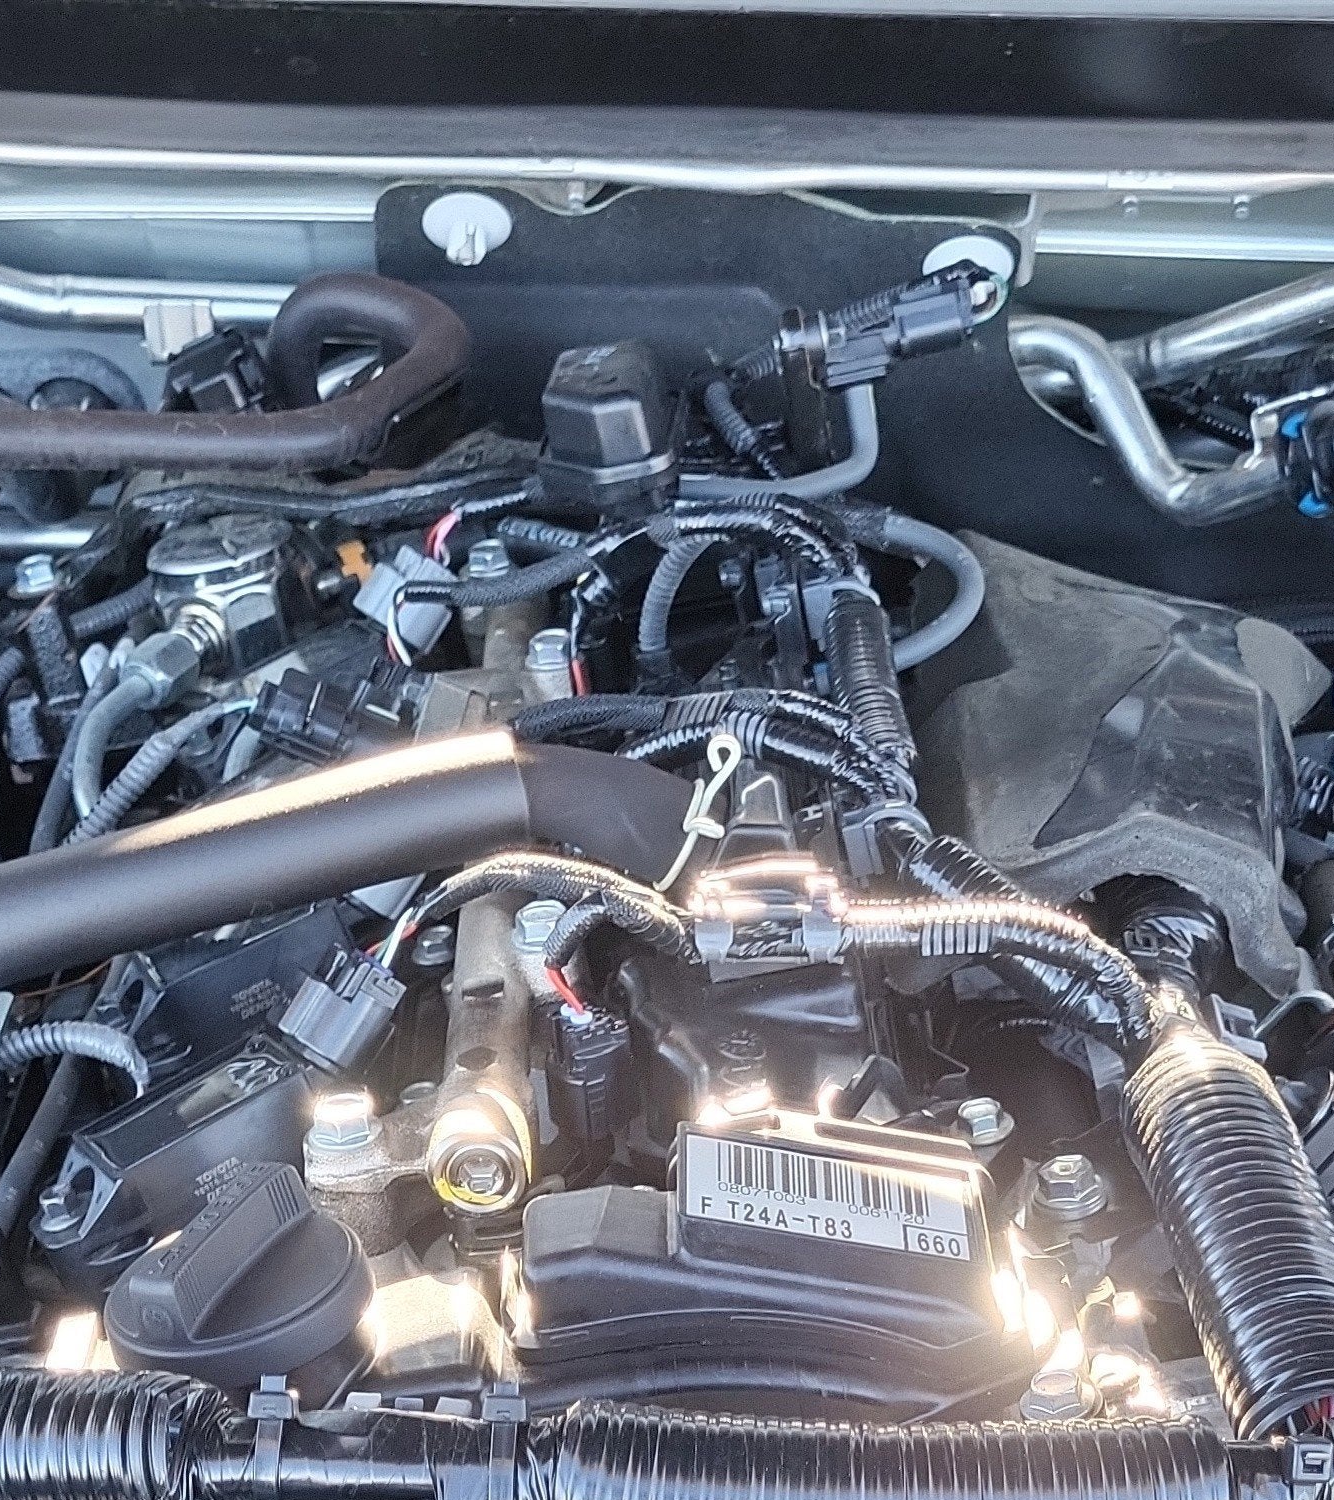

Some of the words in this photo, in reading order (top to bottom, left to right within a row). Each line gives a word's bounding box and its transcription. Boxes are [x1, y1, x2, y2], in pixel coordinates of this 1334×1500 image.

[195, 1156, 240, 1187] TOYOTA
[700, 1195, 713, 1215] F
[727, 1199, 853, 1239] T24A-T83
[718, 1181, 806, 1206] 08071003
[848, 1203, 925, 1225] 0061120
[916, 1233, 962, 1258] 660
